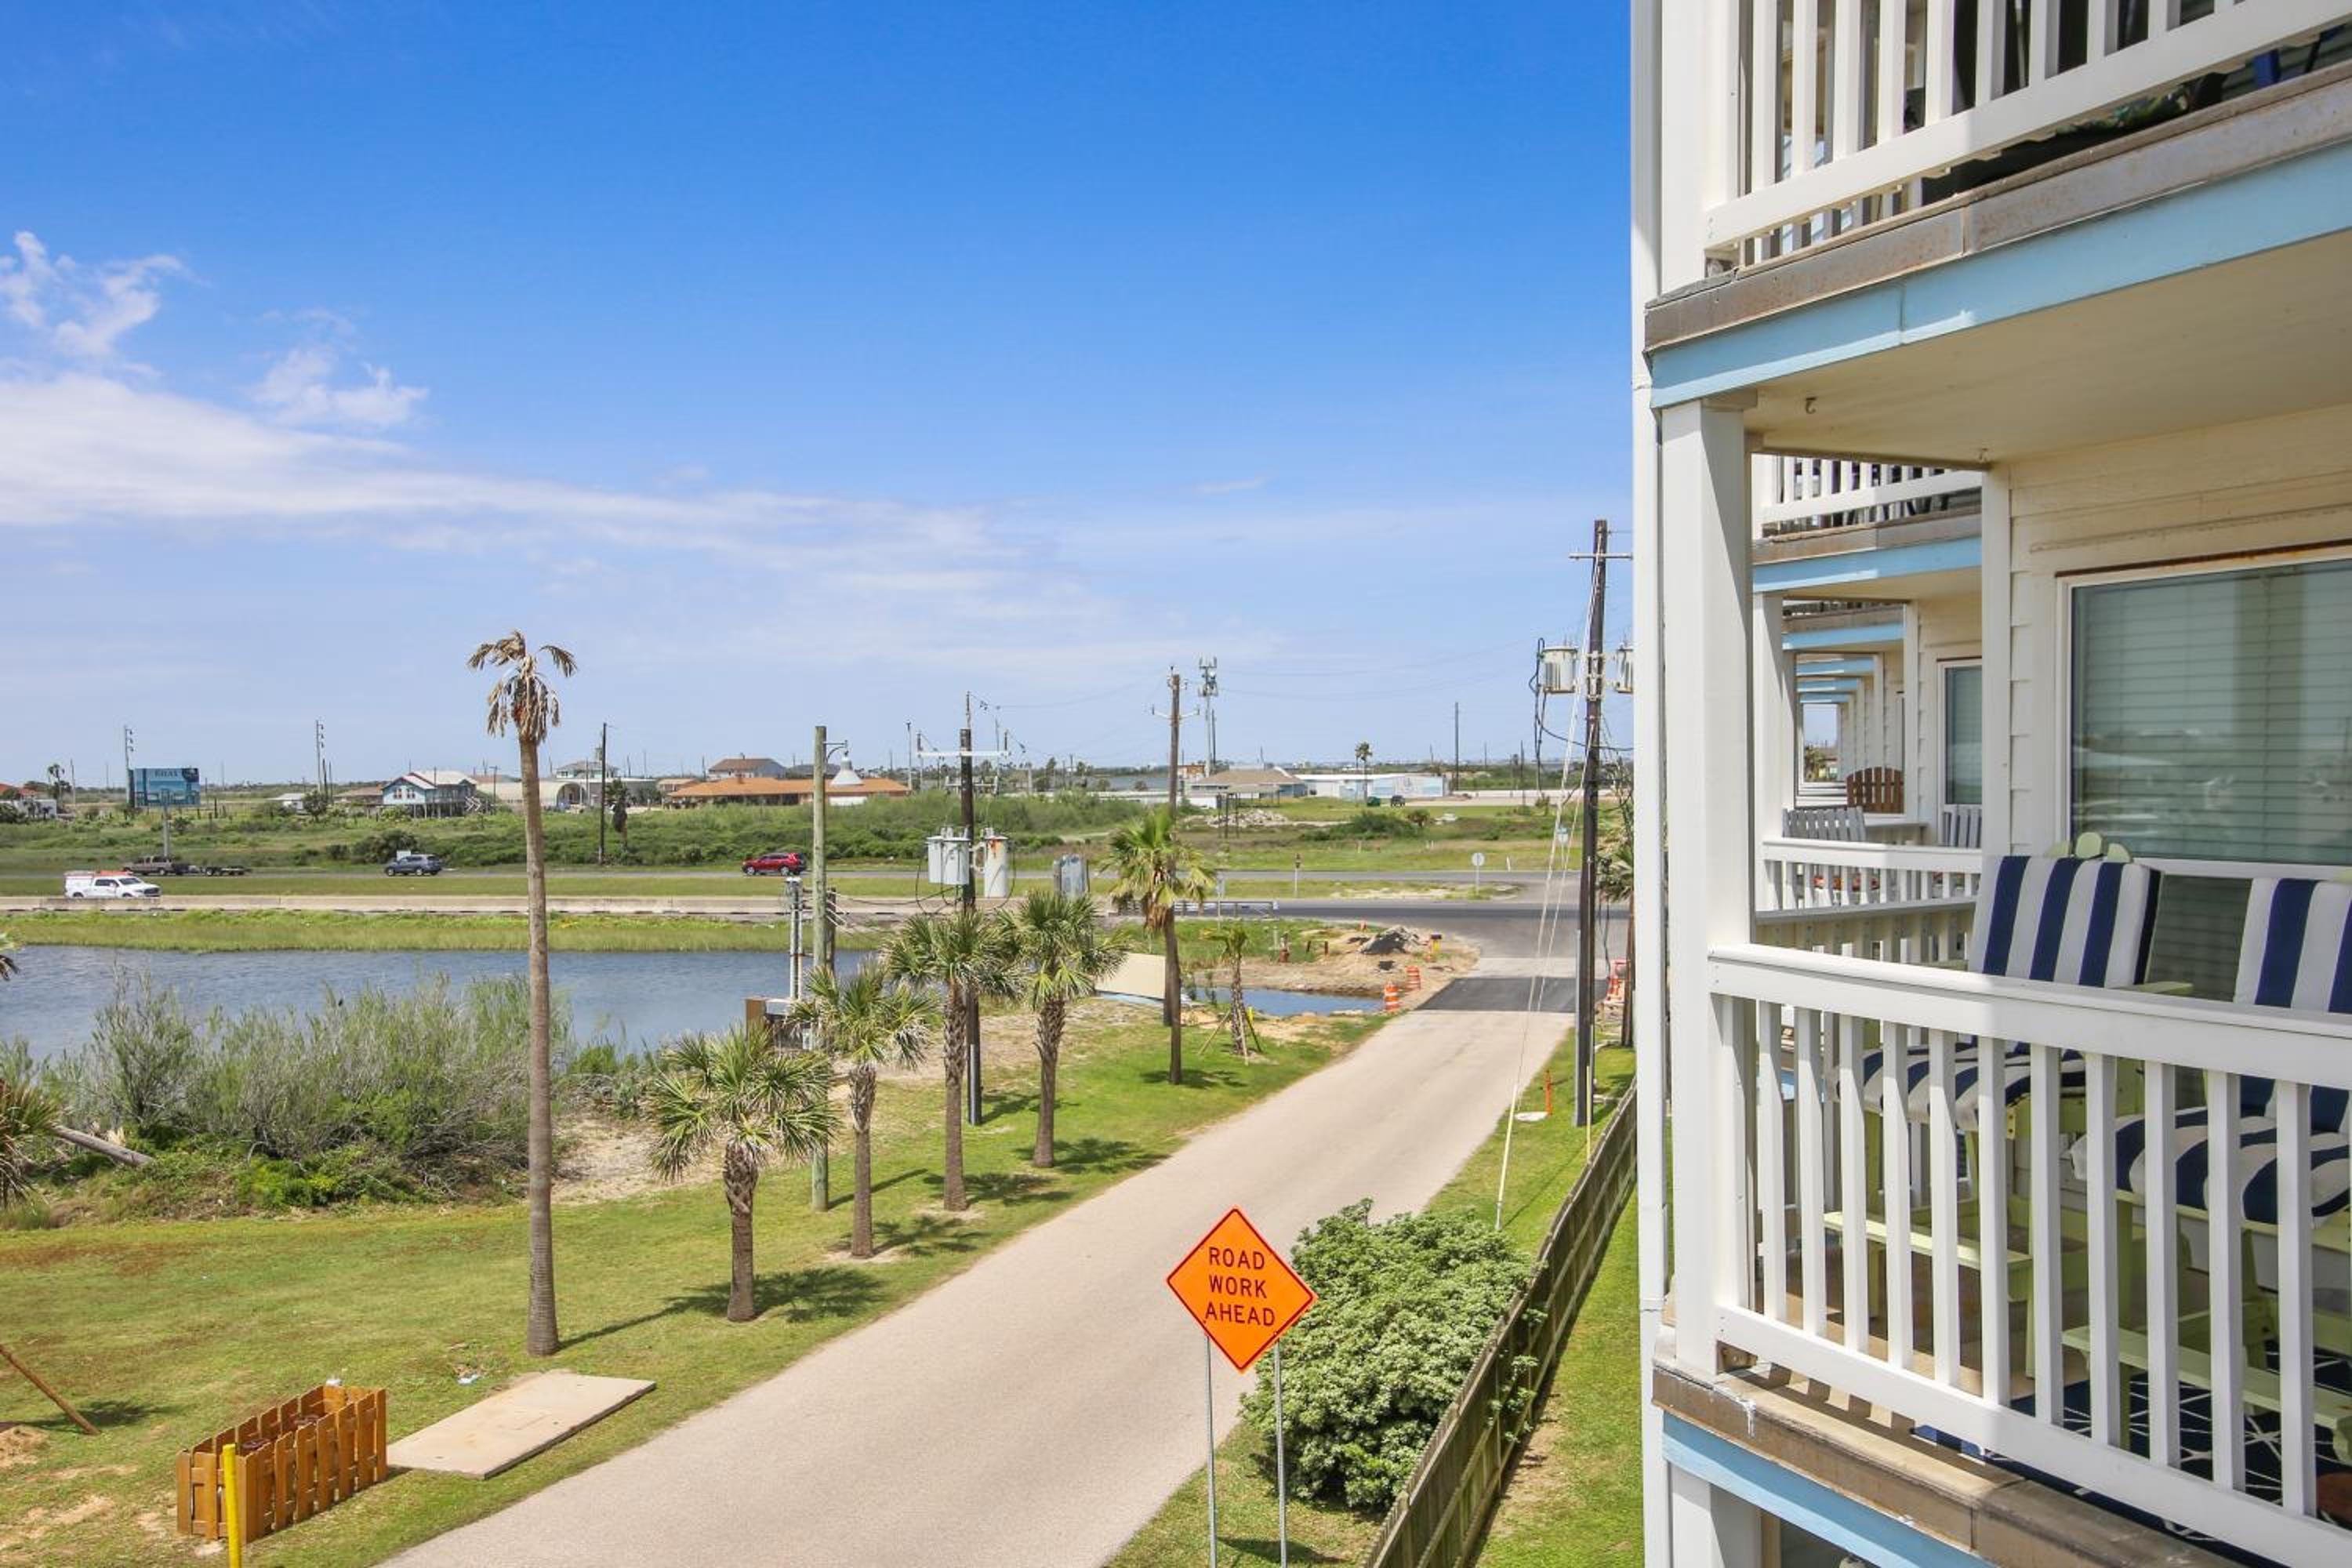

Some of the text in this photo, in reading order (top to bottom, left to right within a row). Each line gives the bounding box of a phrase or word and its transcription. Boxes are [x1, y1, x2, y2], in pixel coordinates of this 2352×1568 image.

[1209, 1247, 1265, 1270] ROAD
[1210, 1275, 1267, 1298] WORK
[1205, 1301, 1276, 1327] AHEAD
